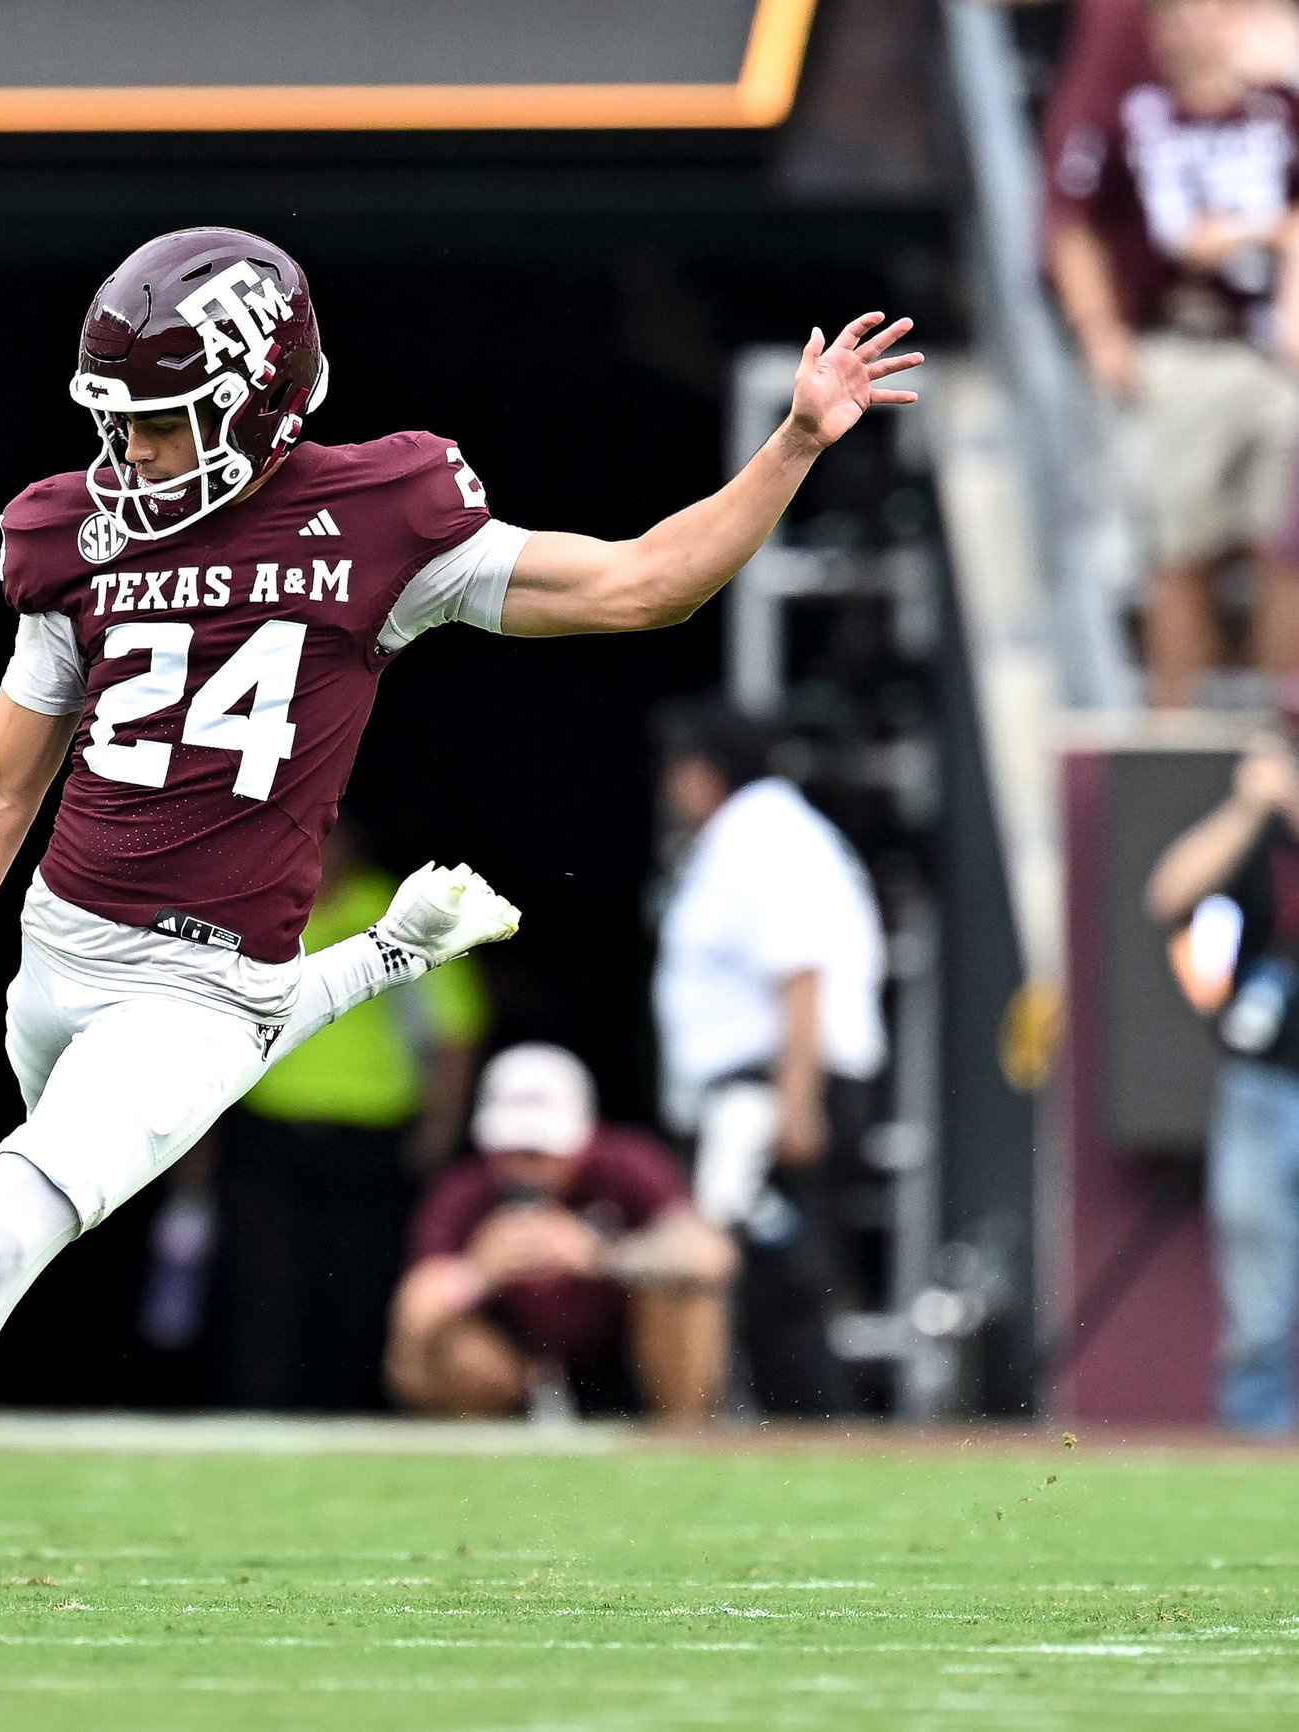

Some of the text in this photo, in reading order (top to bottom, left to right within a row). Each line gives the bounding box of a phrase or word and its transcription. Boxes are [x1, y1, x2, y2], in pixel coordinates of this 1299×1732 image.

[446, 447, 487, 508] 2
[90, 559, 353, 616] TEXAS A&M
[83, 619, 308, 802] 24
